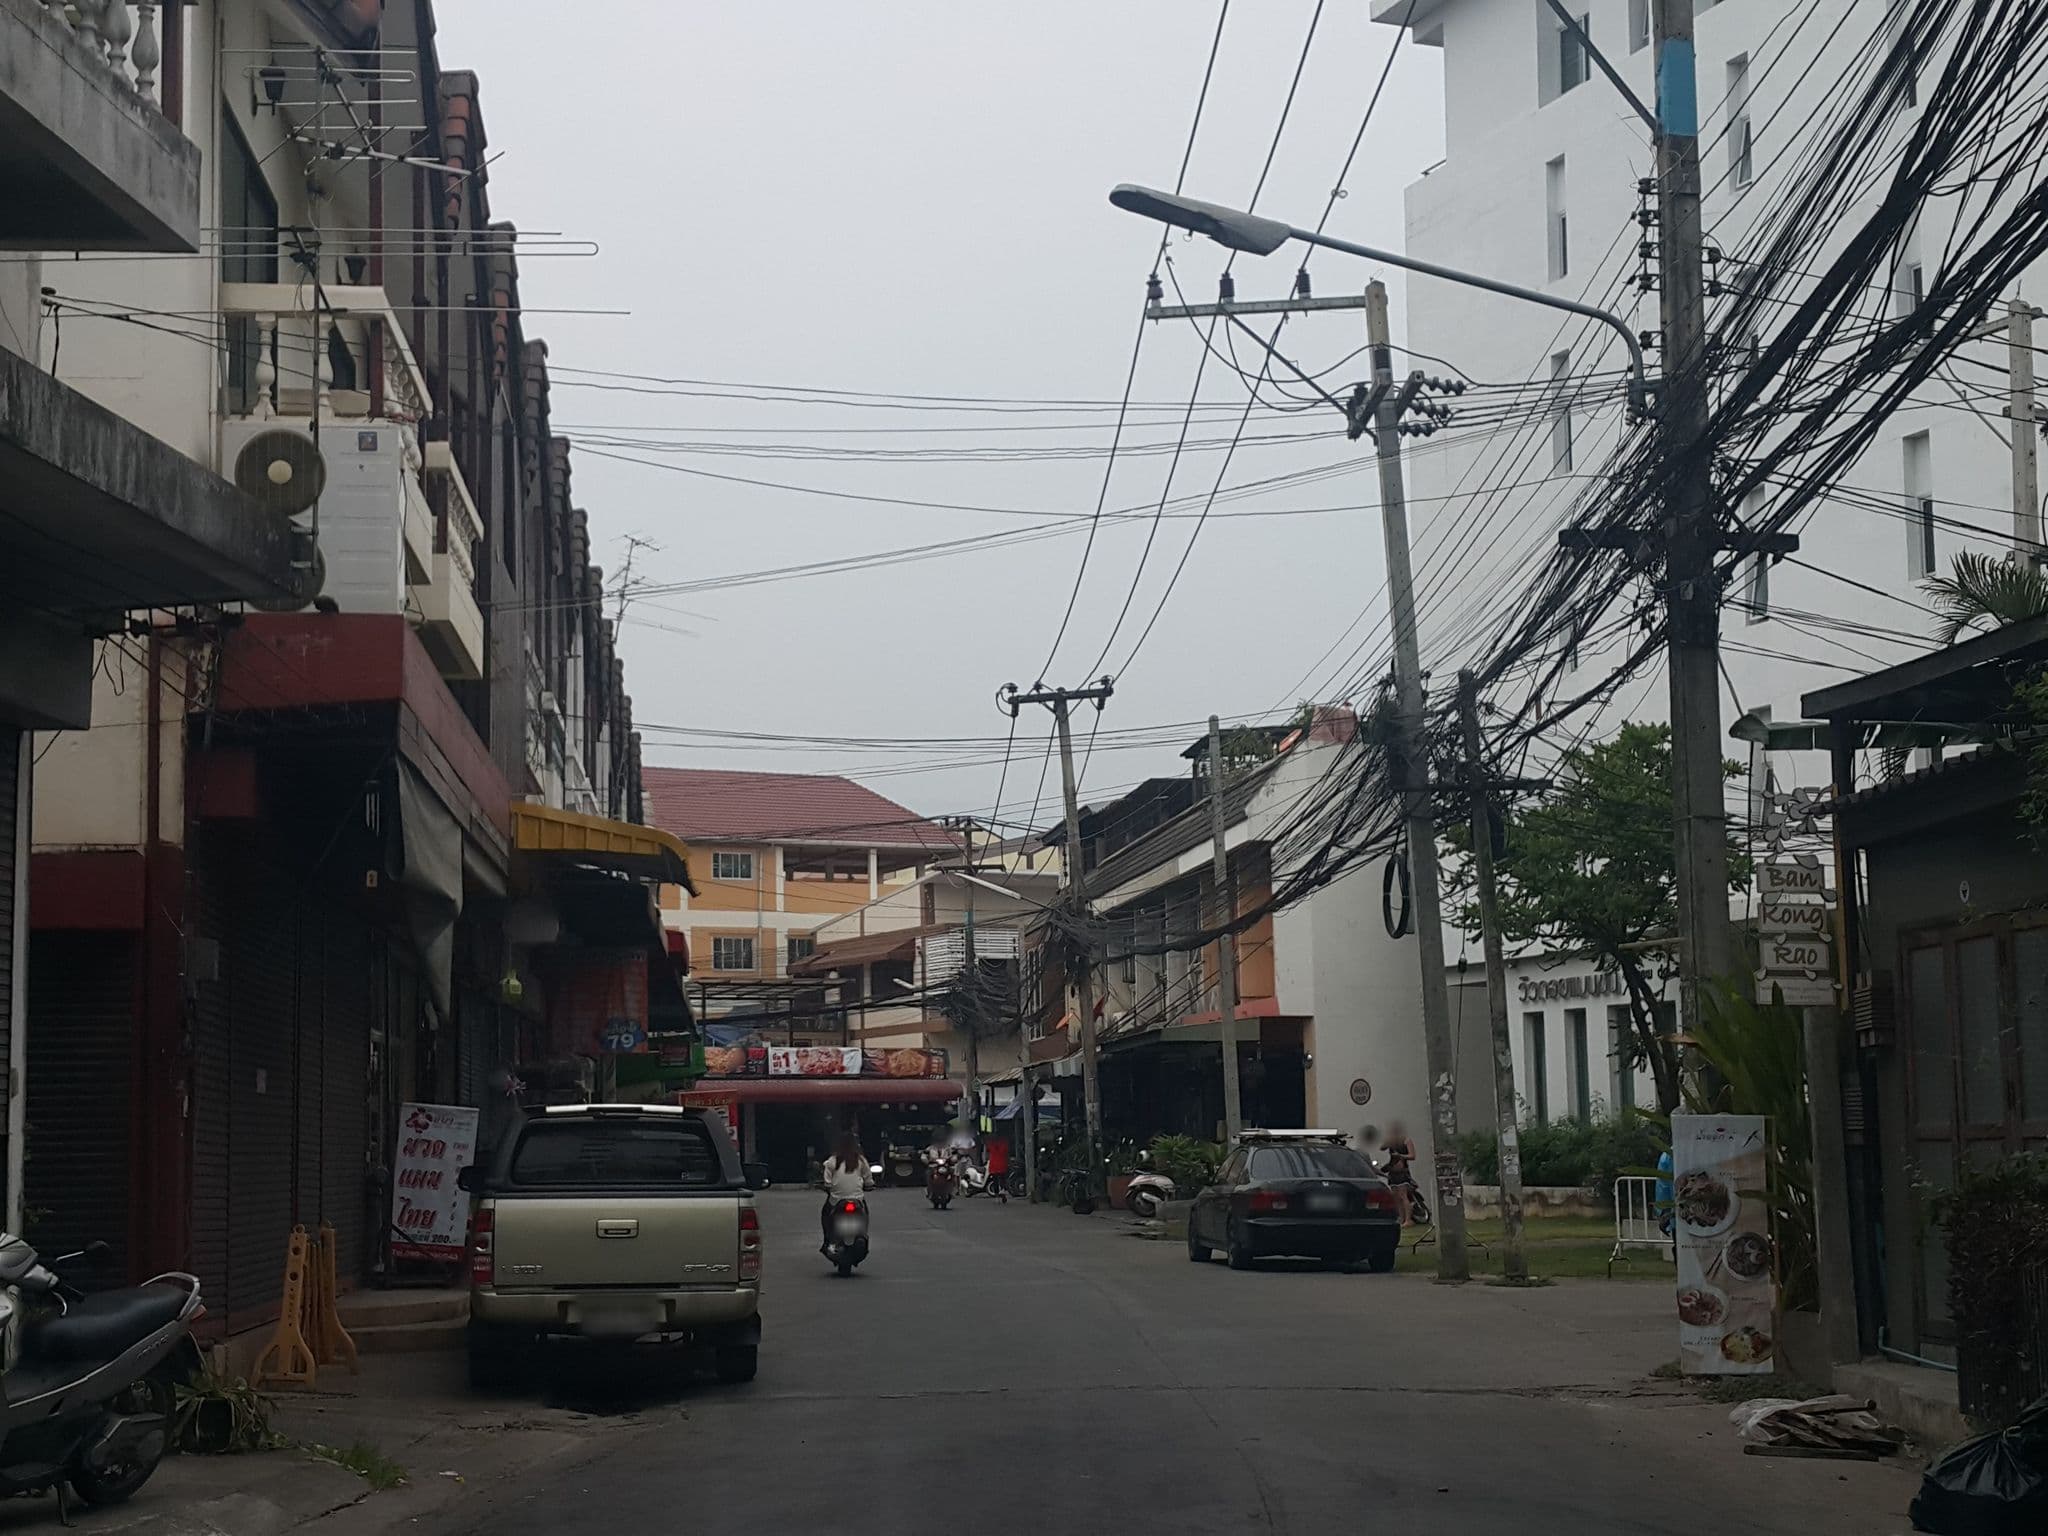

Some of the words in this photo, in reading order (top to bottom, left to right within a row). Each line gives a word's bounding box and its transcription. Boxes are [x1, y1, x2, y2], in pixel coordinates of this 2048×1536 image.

[1766, 868, 1818, 888] Ban
[1763, 904, 1825, 932] Kong
[1773, 946, 1818, 964] Rao
[608, 1034, 634, 1048] 79
